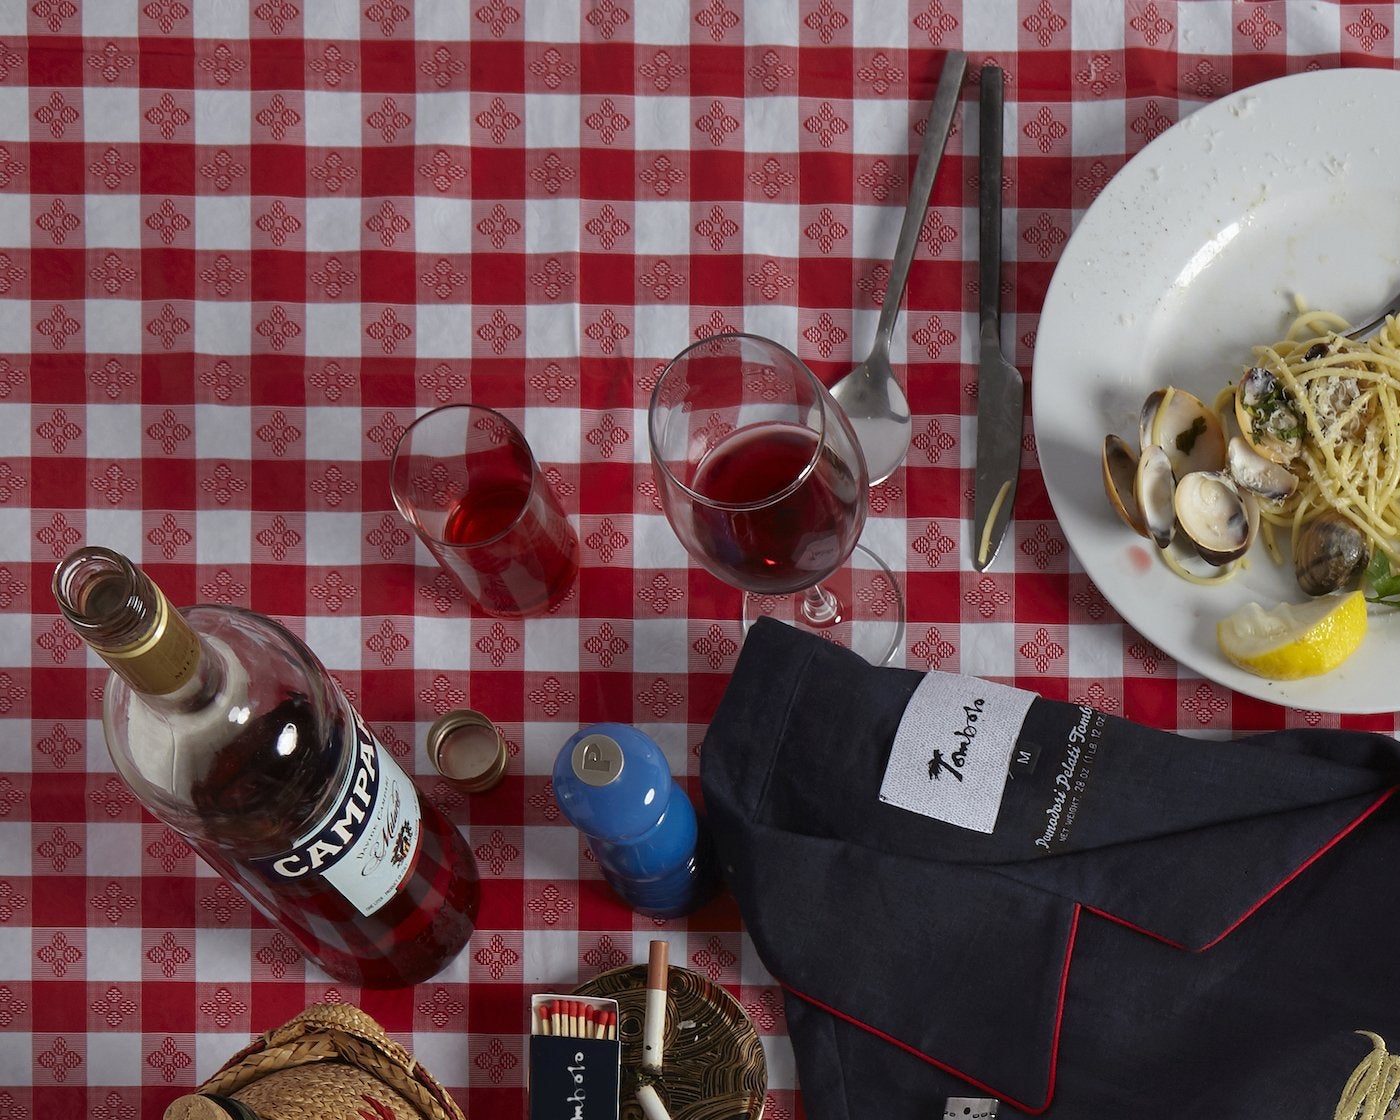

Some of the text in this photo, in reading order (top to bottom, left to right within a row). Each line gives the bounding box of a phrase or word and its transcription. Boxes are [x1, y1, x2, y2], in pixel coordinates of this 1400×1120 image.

[928, 697, 985, 783] Tombolo
[1090, 729, 1101, 739] 12
[1017, 750, 1032, 765] M
[1079, 768, 1090, 779] OZ
[1074, 780, 1085, 792] 28
[1034, 788, 1067, 850] Pomodori
[1055, 744, 1082, 791] Pelati
[1059, 827, 1070, 842] NET
